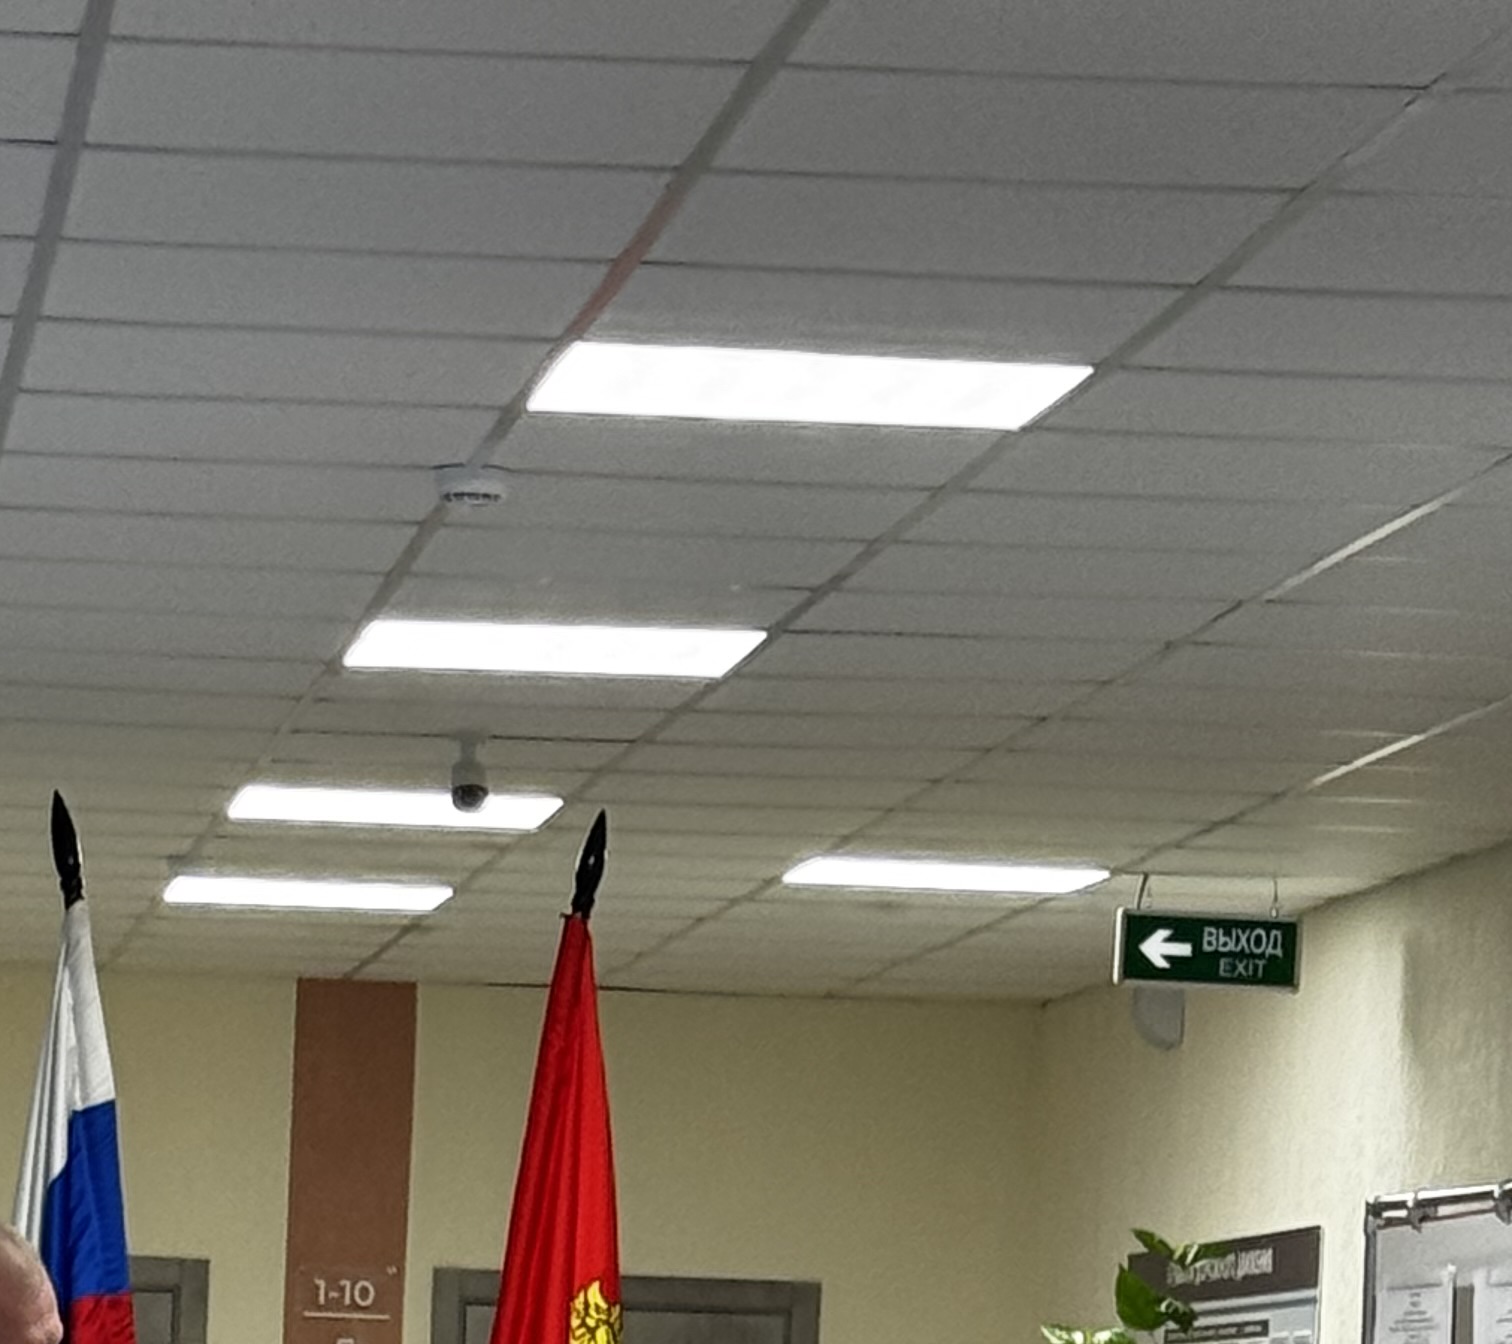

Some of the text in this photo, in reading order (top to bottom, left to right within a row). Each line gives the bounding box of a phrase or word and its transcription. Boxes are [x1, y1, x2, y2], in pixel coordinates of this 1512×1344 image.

[1202, 925, 1284, 959] ВЫХОД
[1218, 957, 1268, 979] EXIT
[314, 1278, 375, 1308] 1-10
